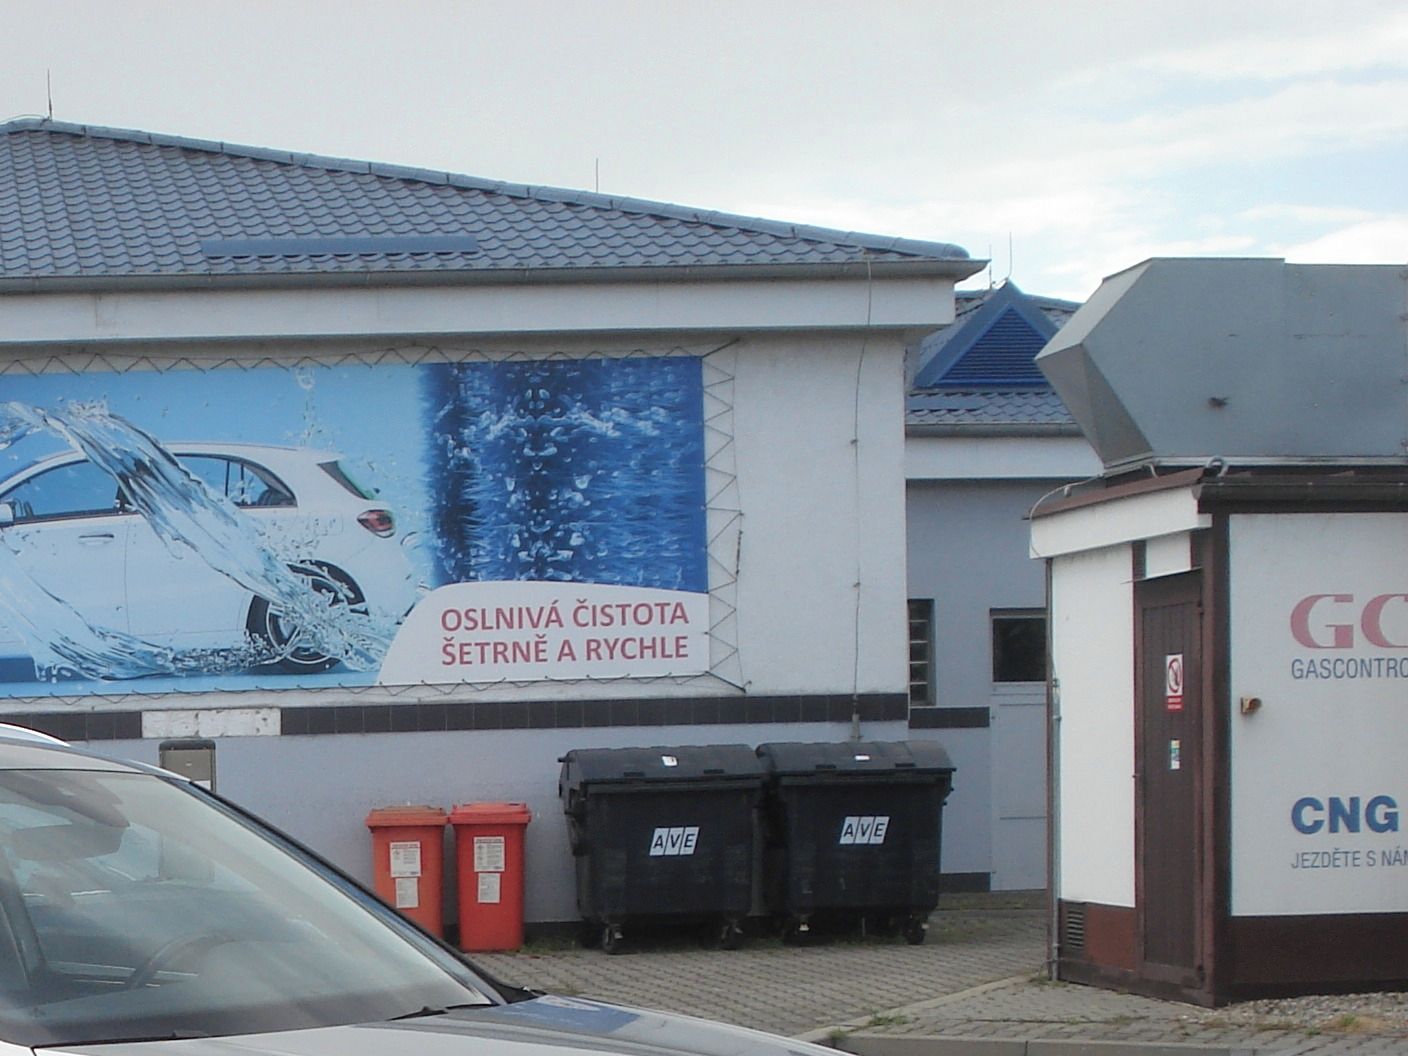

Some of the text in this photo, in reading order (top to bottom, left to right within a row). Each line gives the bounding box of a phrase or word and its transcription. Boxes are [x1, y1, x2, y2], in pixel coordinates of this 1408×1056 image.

[440, 598, 689, 632] OSLNIVÁ ČISTOTA
[441, 633, 688, 666] ŠETRNĚ A RYCHLE
[1291, 795, 1399, 834] CNG
[652, 833, 696, 849] AVE
[843, 822, 886, 838] AVE
[1291, 847, 1361, 869] JEZDĚTE
[1366, 849, 1377, 867] S
